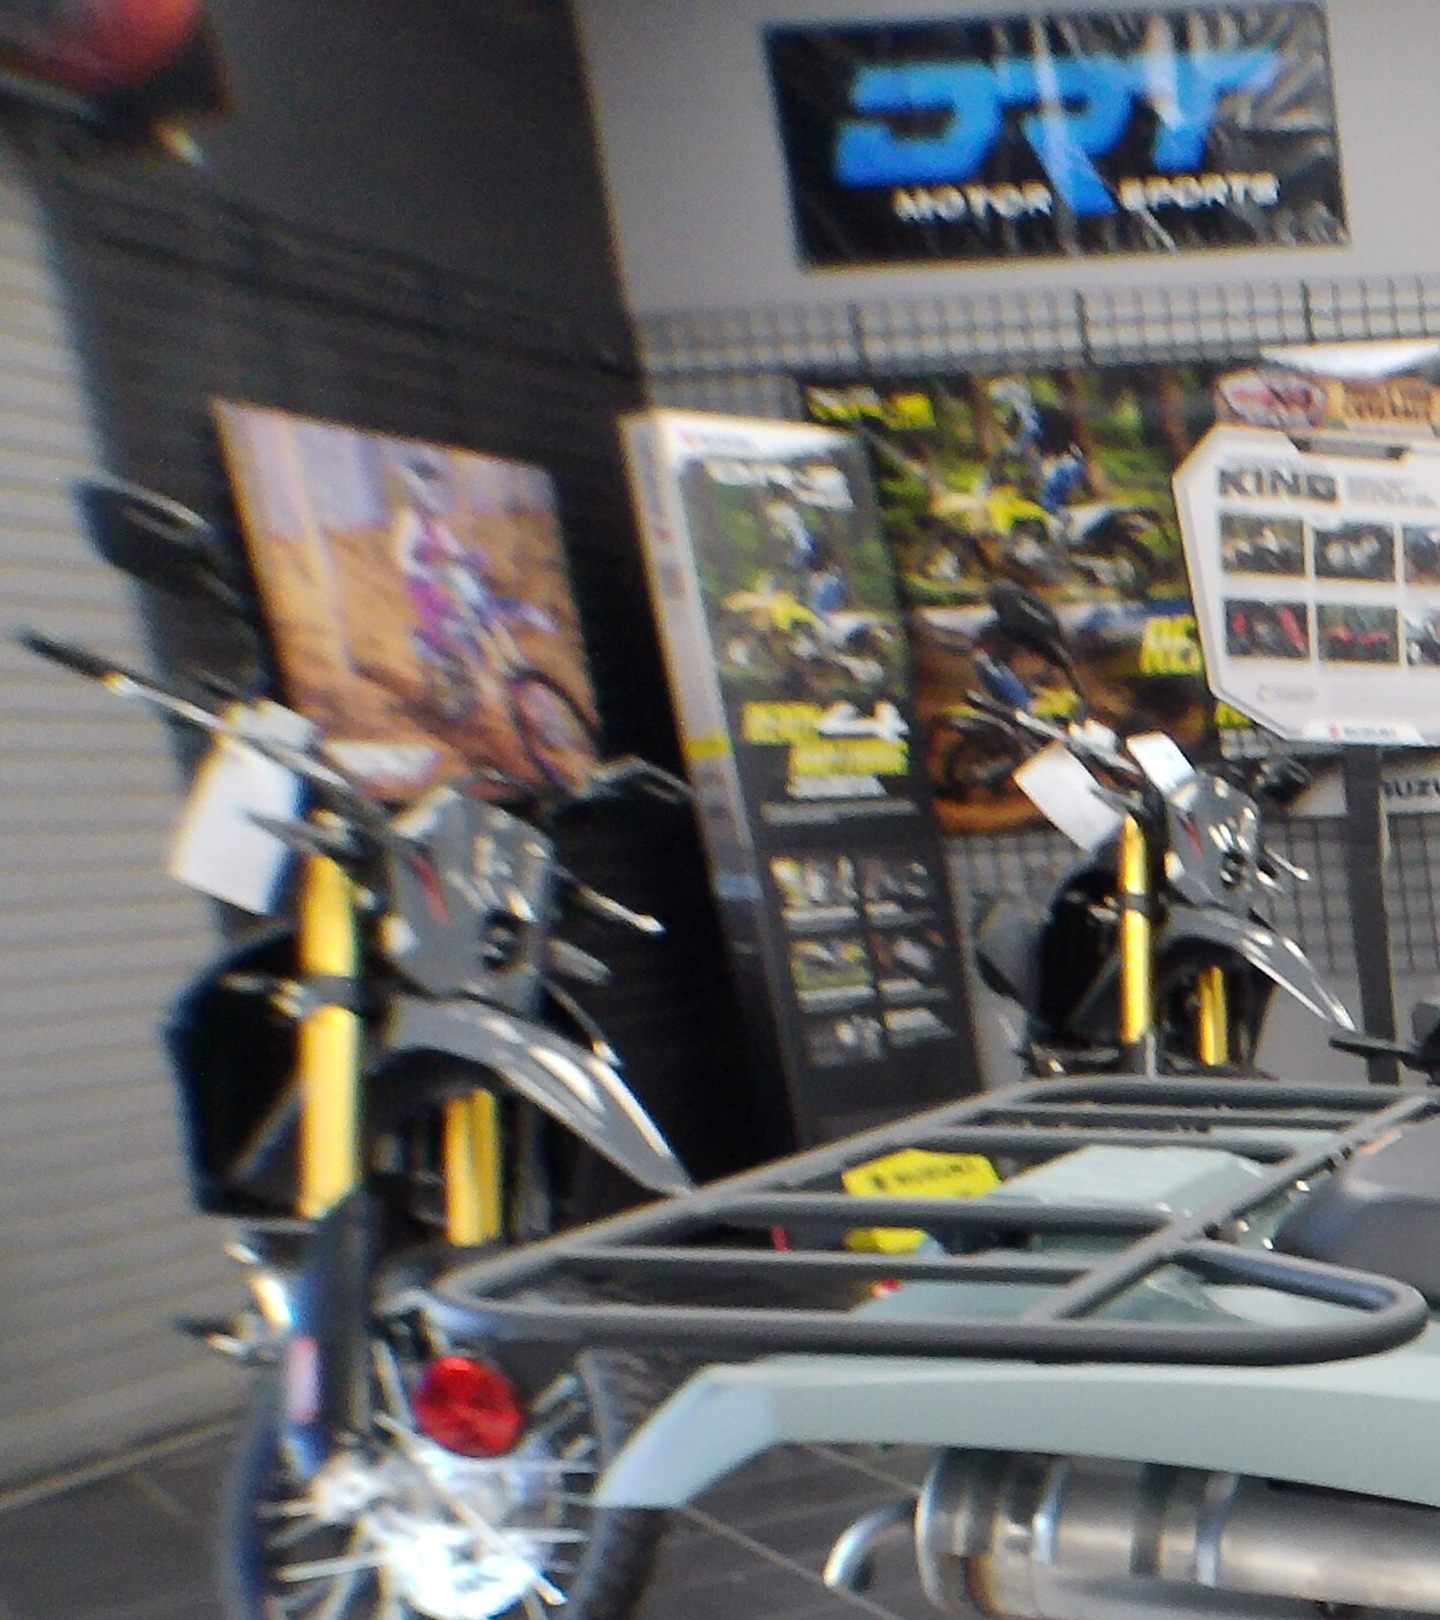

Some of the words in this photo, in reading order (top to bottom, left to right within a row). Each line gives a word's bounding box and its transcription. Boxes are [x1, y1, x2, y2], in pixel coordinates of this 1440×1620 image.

[894, 179, 1053, 222] MOTOR
[1118, 171, 1280, 212] SPORTS
[1218, 466, 1338, 503] KING
